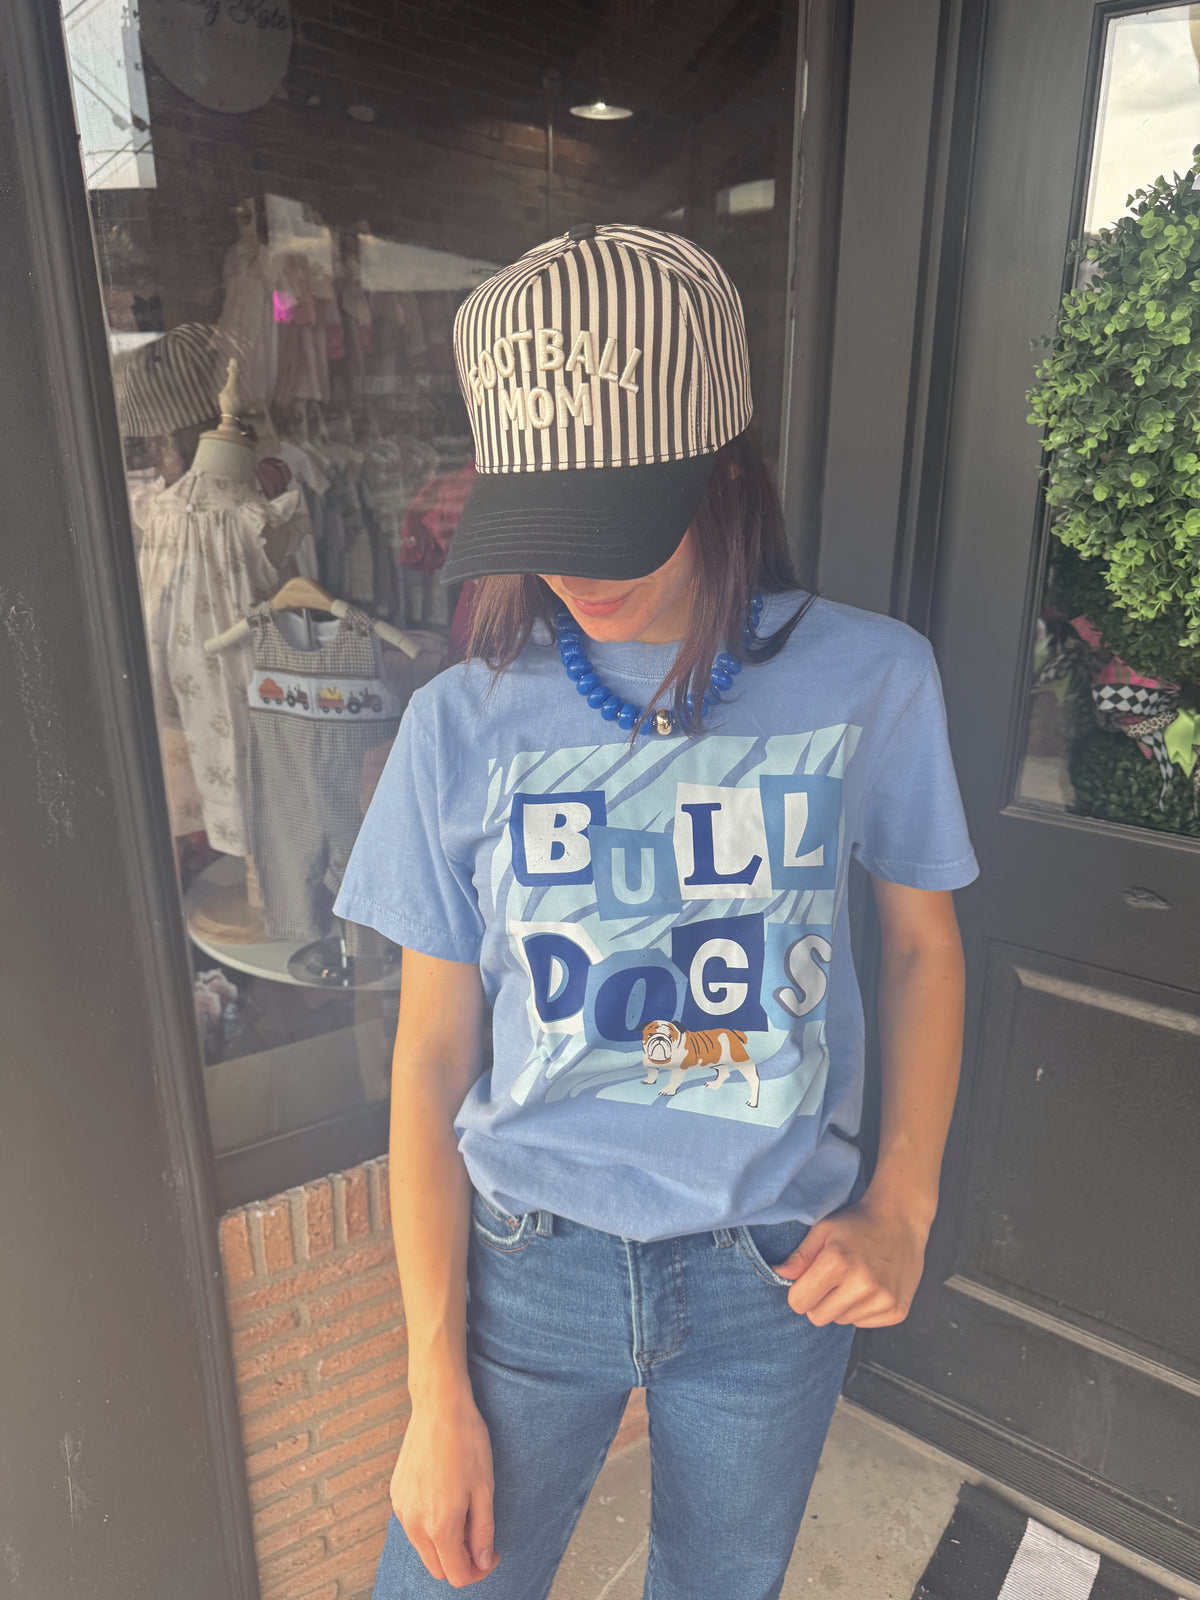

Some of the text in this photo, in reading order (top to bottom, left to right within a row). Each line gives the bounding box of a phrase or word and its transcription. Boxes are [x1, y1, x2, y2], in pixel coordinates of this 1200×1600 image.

[468, 328, 642, 406] FOOTBALL
[500, 382, 593, 431] MOM
[523, 791, 824, 905] BULL
[522, 932, 833, 1042] DOGS
